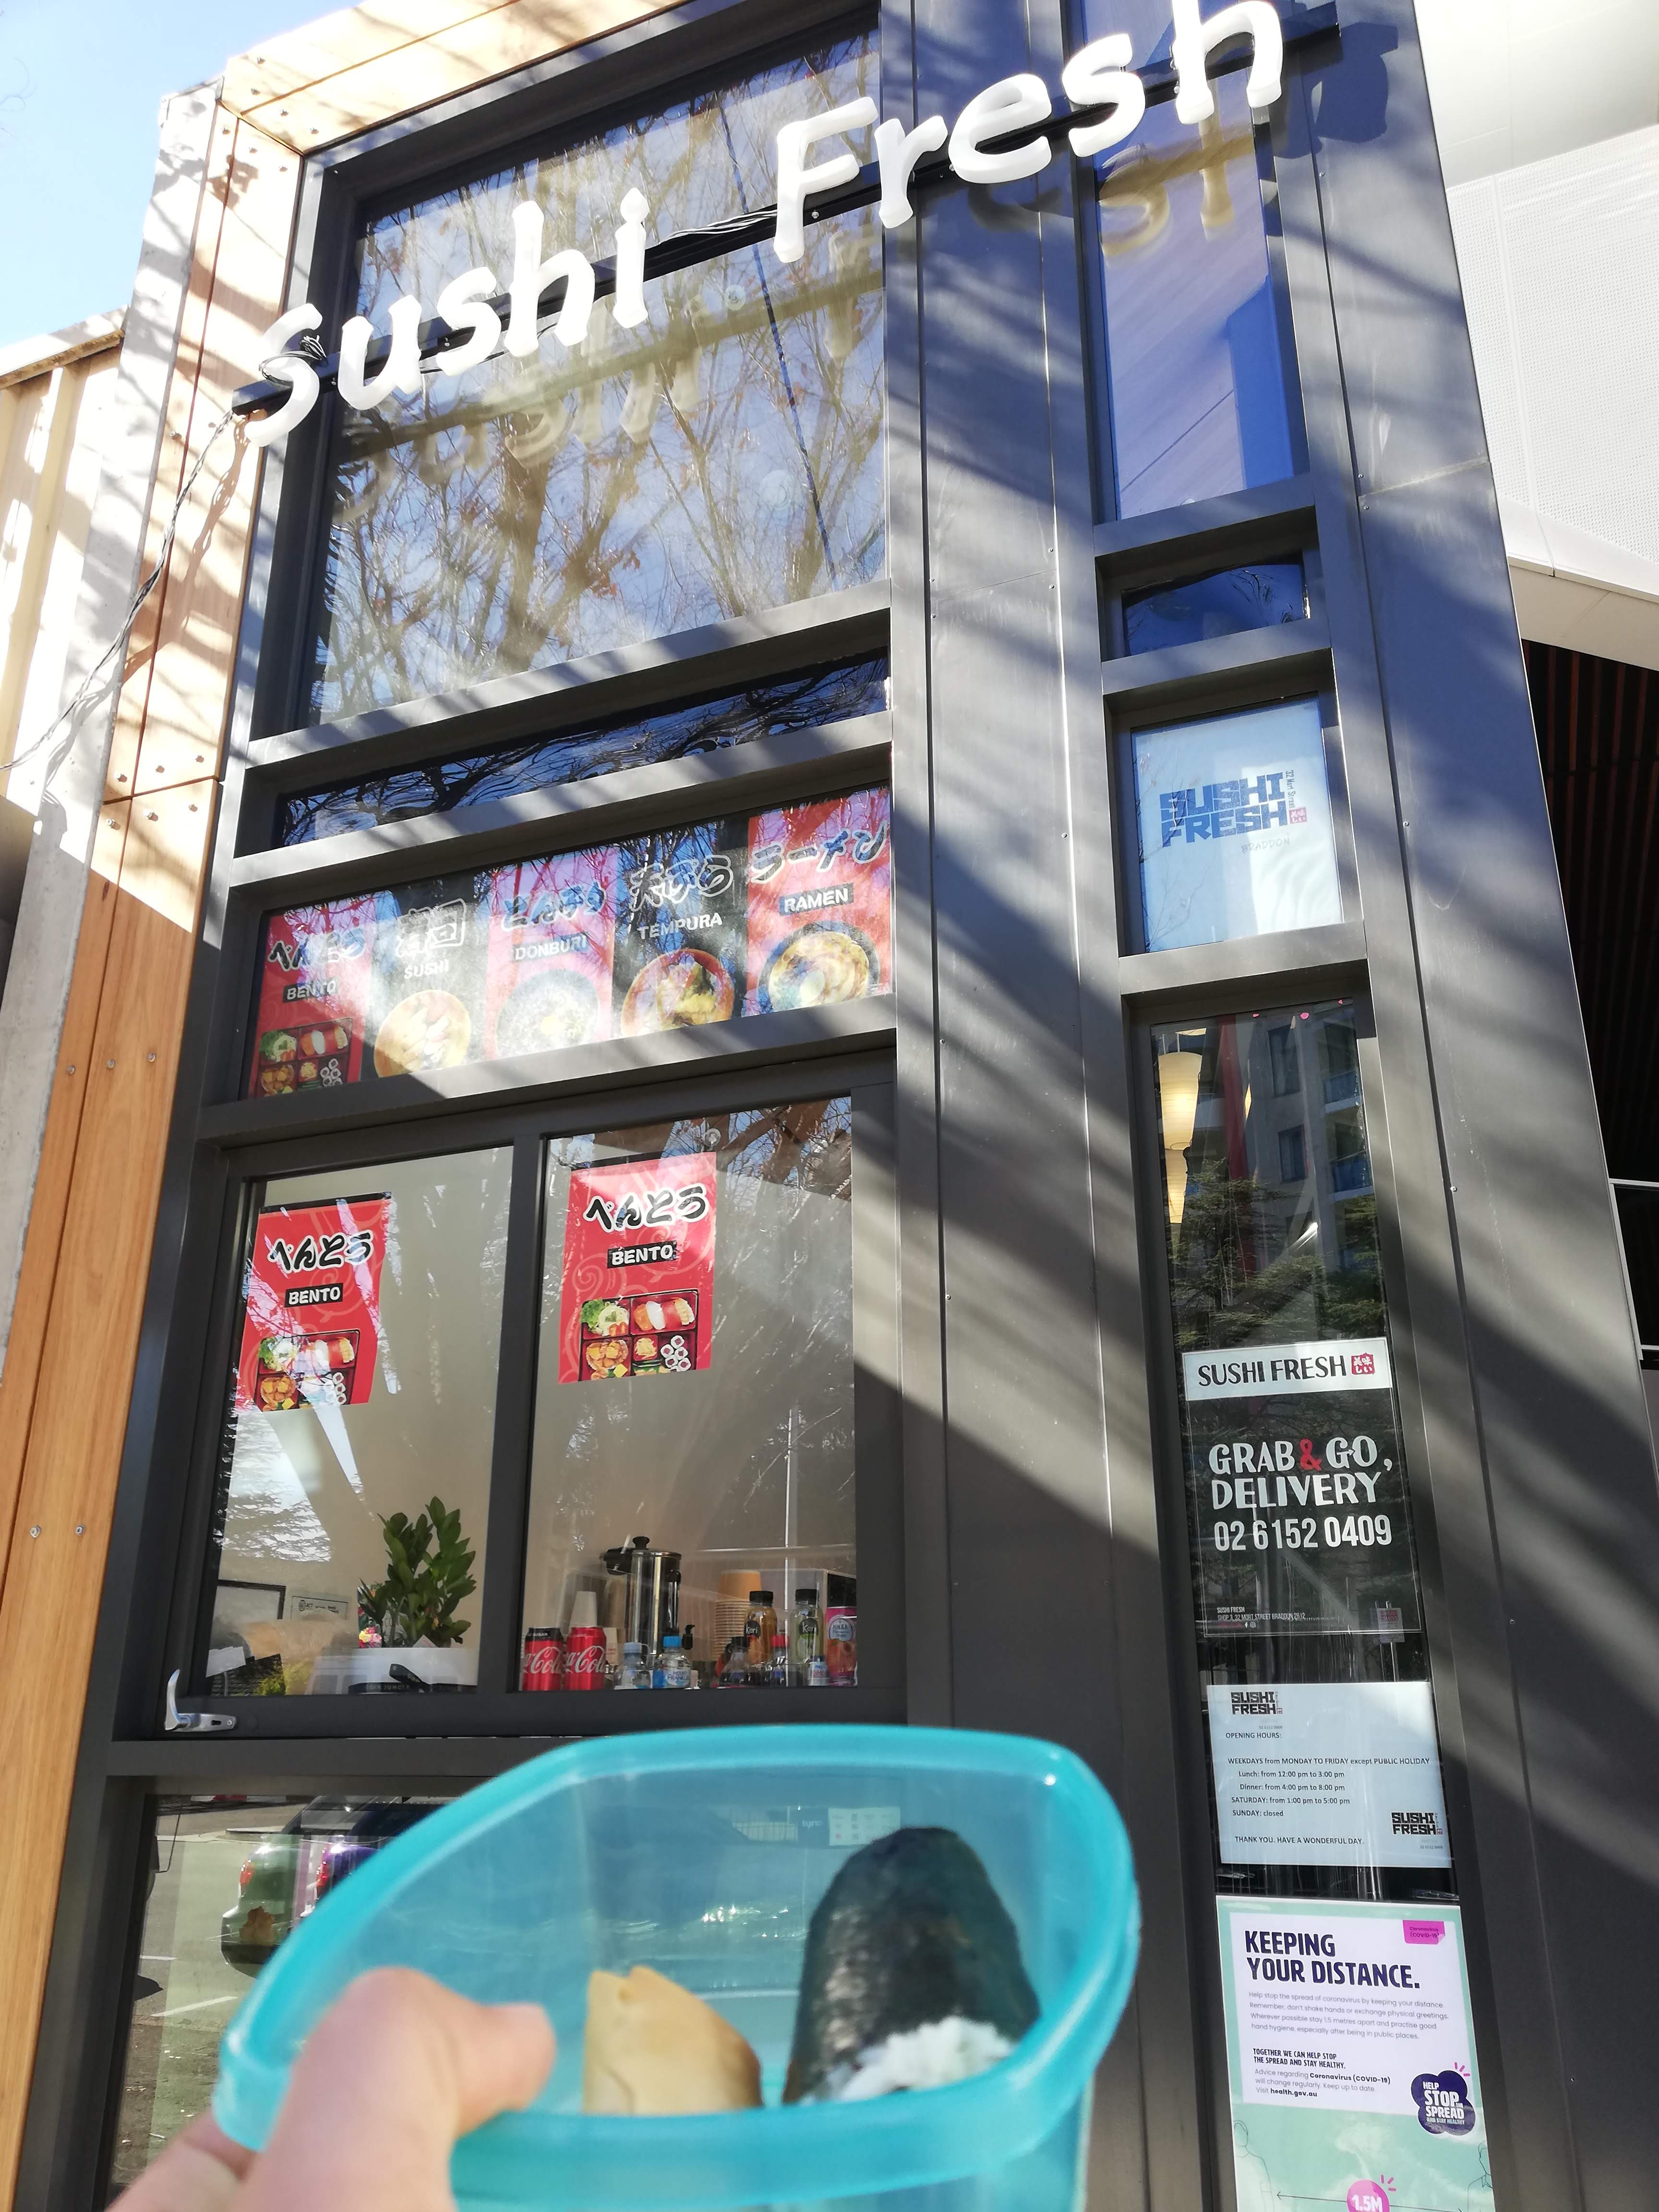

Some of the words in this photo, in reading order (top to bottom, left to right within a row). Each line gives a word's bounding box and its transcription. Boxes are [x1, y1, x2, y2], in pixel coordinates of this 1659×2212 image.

[244, 188, 650, 449] Sushi
[773, 0, 1284, 264] Fresh
[1159, 772, 1285, 824] SUSHI
[1161, 801, 1288, 848] FRESH
[751, 819, 889, 885] ラーメン
[1242, 838, 1289, 854] BRADDON
[783, 889, 849, 913] RAMEN
[637, 913, 722, 939] TEMPURA
[515, 935, 587, 960] DONBURI
[404, 959, 449, 979] SUSHI
[287, 979, 336, 1000] BENTO
[584, 1183, 708, 1233] べんとう
[267, 1229, 373, 1274] べんとう
[612, 1244, 674, 1266] BENTO
[289, 1287, 341, 1305] BENTO
[1198, 1360, 1264, 1387] SUSHI
[1271, 1355, 1346, 1382] FRESH
[1209, 1441, 1296, 1476] GRAB
[1299, 1438, 1322, 1471] &
[1211, 1471, 1382, 1510] DELIVERY
[1214, 1520, 1246, 1551] 02
[1253, 1517, 1318, 1550] 6152
[1324, 1515, 1393, 1548] 0409
[1231, 1692, 1275, 1703] SUSHI
[1232, 1704, 1276, 1715] FRESH
[1392, 1813, 1435, 1824] SUSHI
[1393, 1824, 1436, 1835] FRESH
[1244, 1930, 1336, 1958] KEEPING
[1246, 1957, 1306, 1983] YOUR
[1312, 1960, 1420, 1989] DISTANCE.
[1371, 1998, 1396, 2007] keeping
[1355, 2008, 1386, 2017] exchange
[1416, 2012, 1449, 2020] greetings.
[1253, 2048, 1281, 2056] TOGETHER
[1319, 2061, 1346, 2069] HEALTHY.
[1267, 2079, 1290, 2088] change
[1277, 2071, 1309, 2080] regarding
[1310, 2073, 1352, 2081] Coronavirus
[1353, 2074, 1391, 2085] (COVID-19)
[1423, 2081, 1439, 2090] HELP
[1271, 2088, 1317, 2097] health.gov.au
[1424, 2090, 1459, 2107] STOP
[1426, 2105, 1464, 2119] SPREAD
[1352, 2194, 1382, 2212] 1.5M
